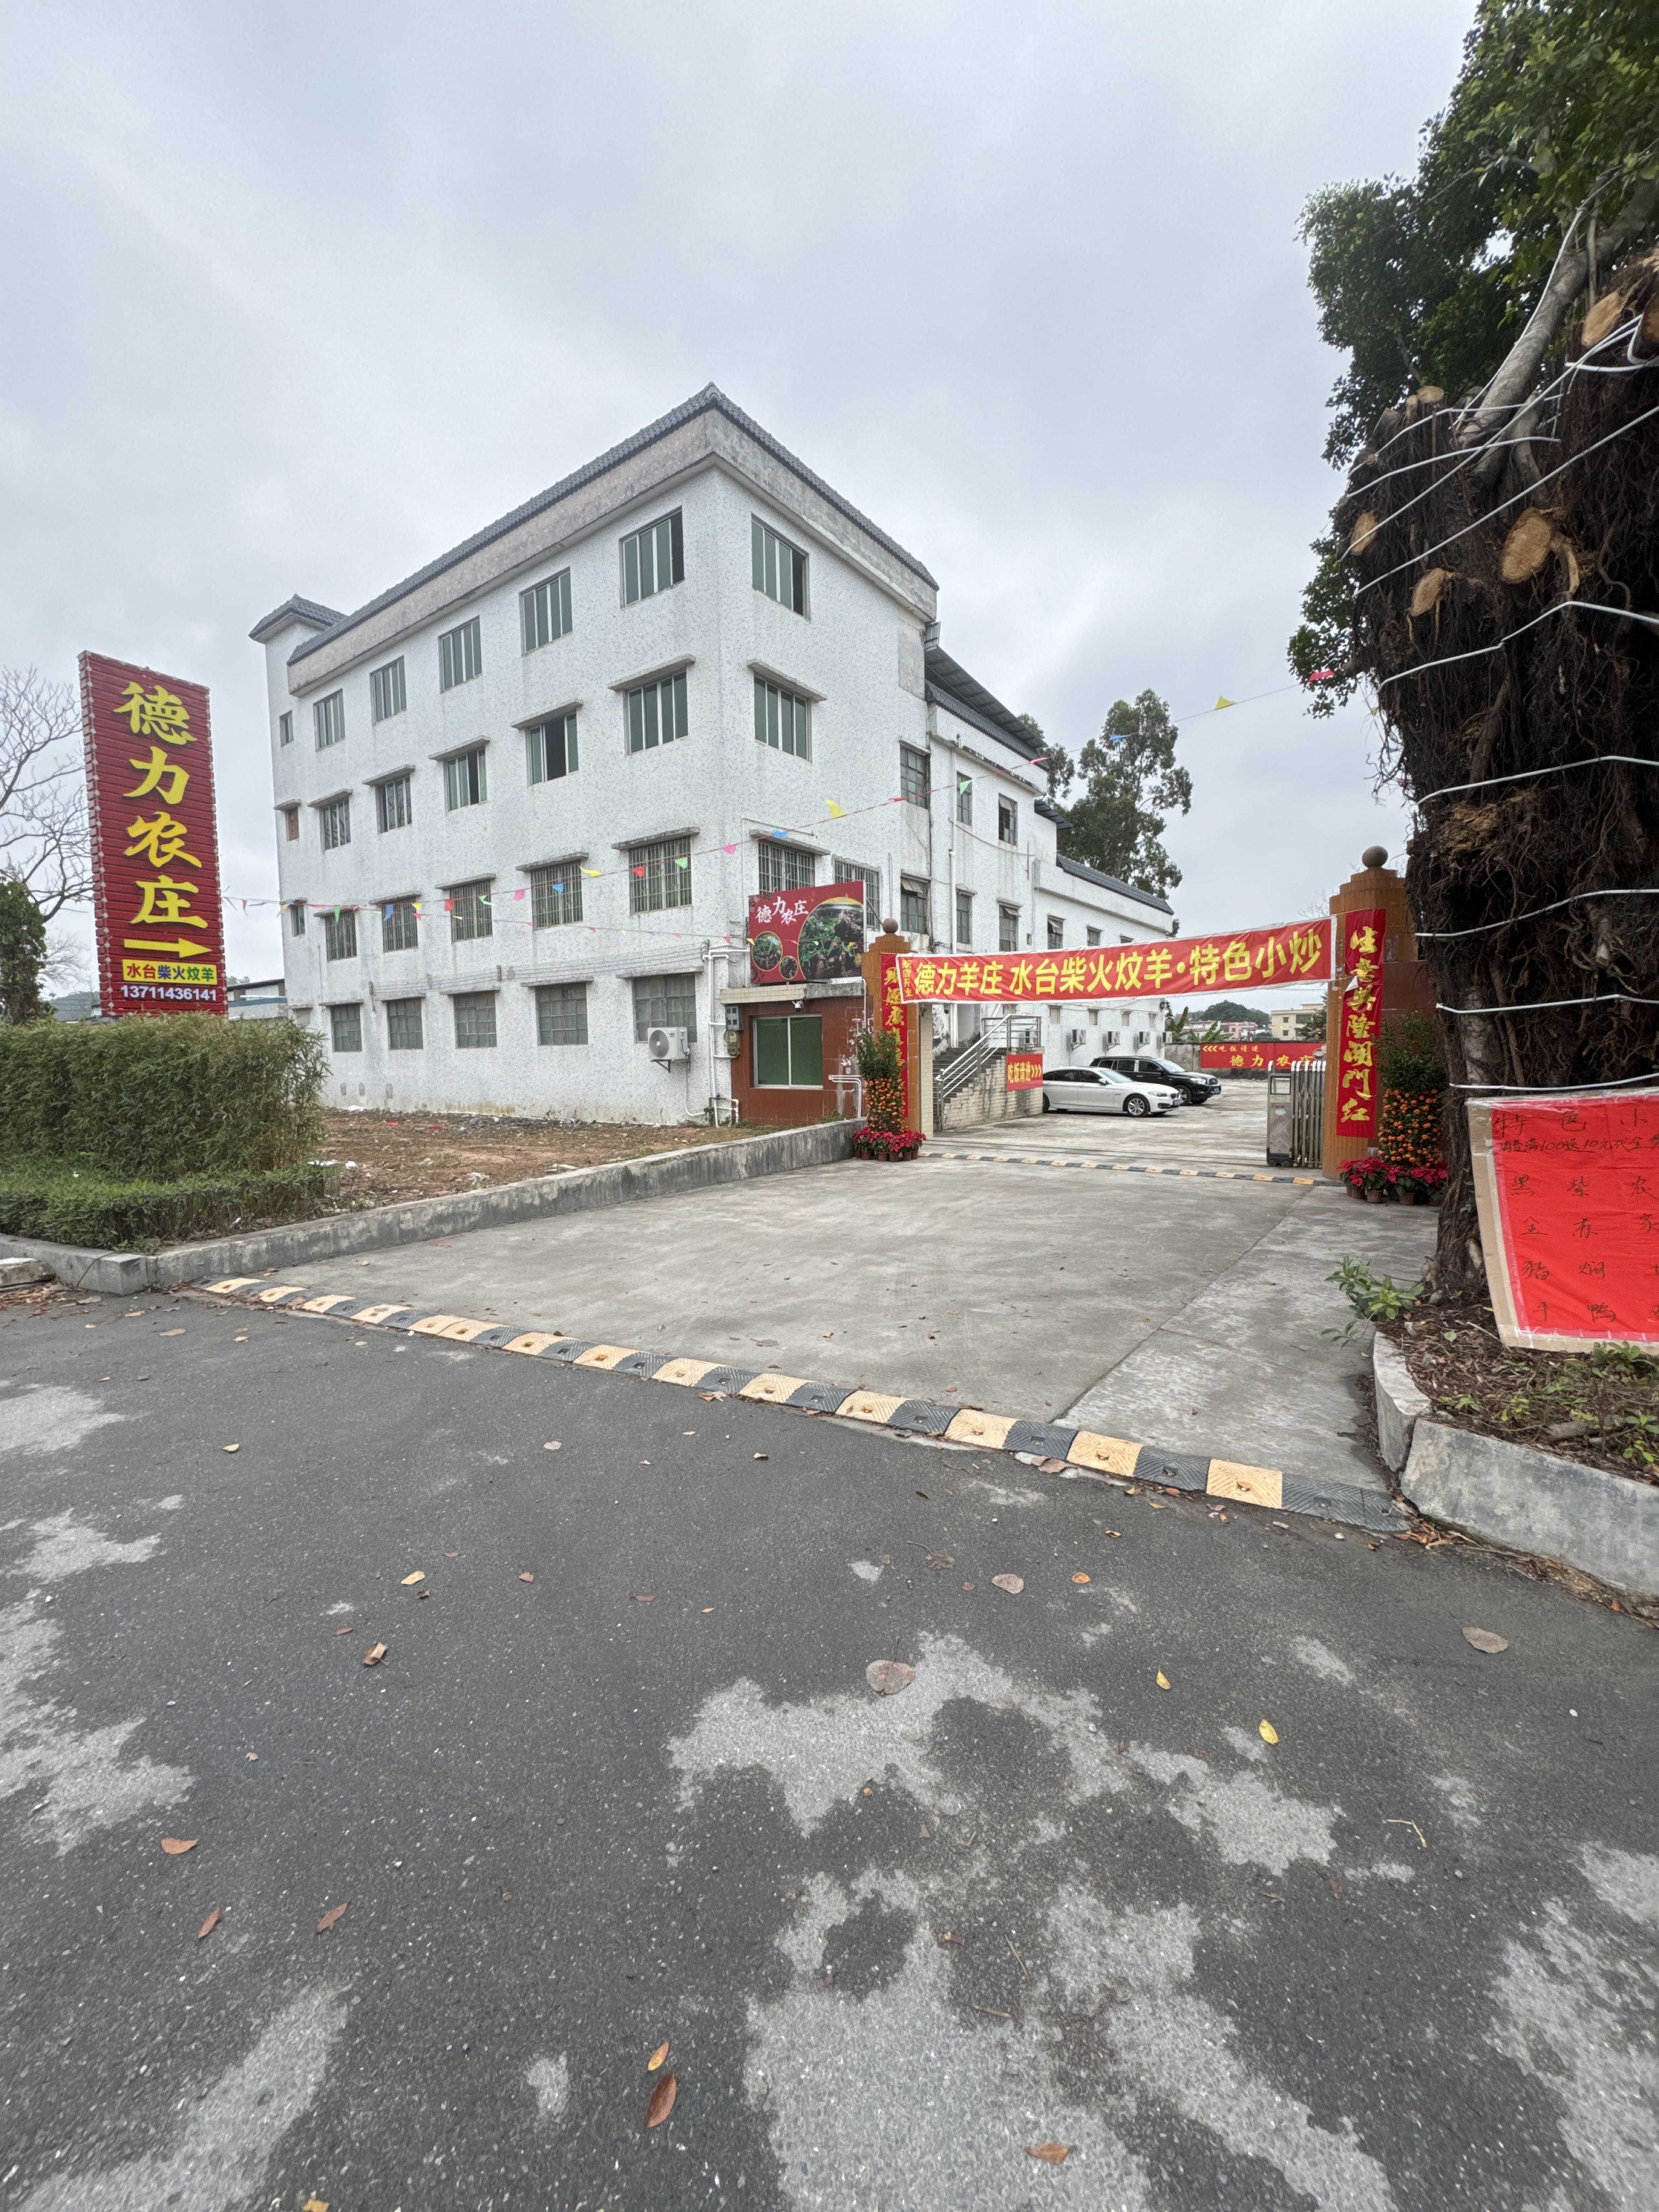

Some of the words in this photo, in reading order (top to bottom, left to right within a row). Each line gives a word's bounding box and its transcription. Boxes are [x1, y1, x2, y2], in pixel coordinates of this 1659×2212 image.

[113, 681, 209, 929] 德力农庄
[755, 896, 810, 924] 德力农庄
[127, 963, 215, 982] 水台柴火炆羊
[901, 959, 914, 997] 新店开业
[914, 960, 1004, 996] 德力羊庄
[121, 985, 217, 1001] 13711436141
[1008, 1061, 1031, 1083] 吃饭请进
